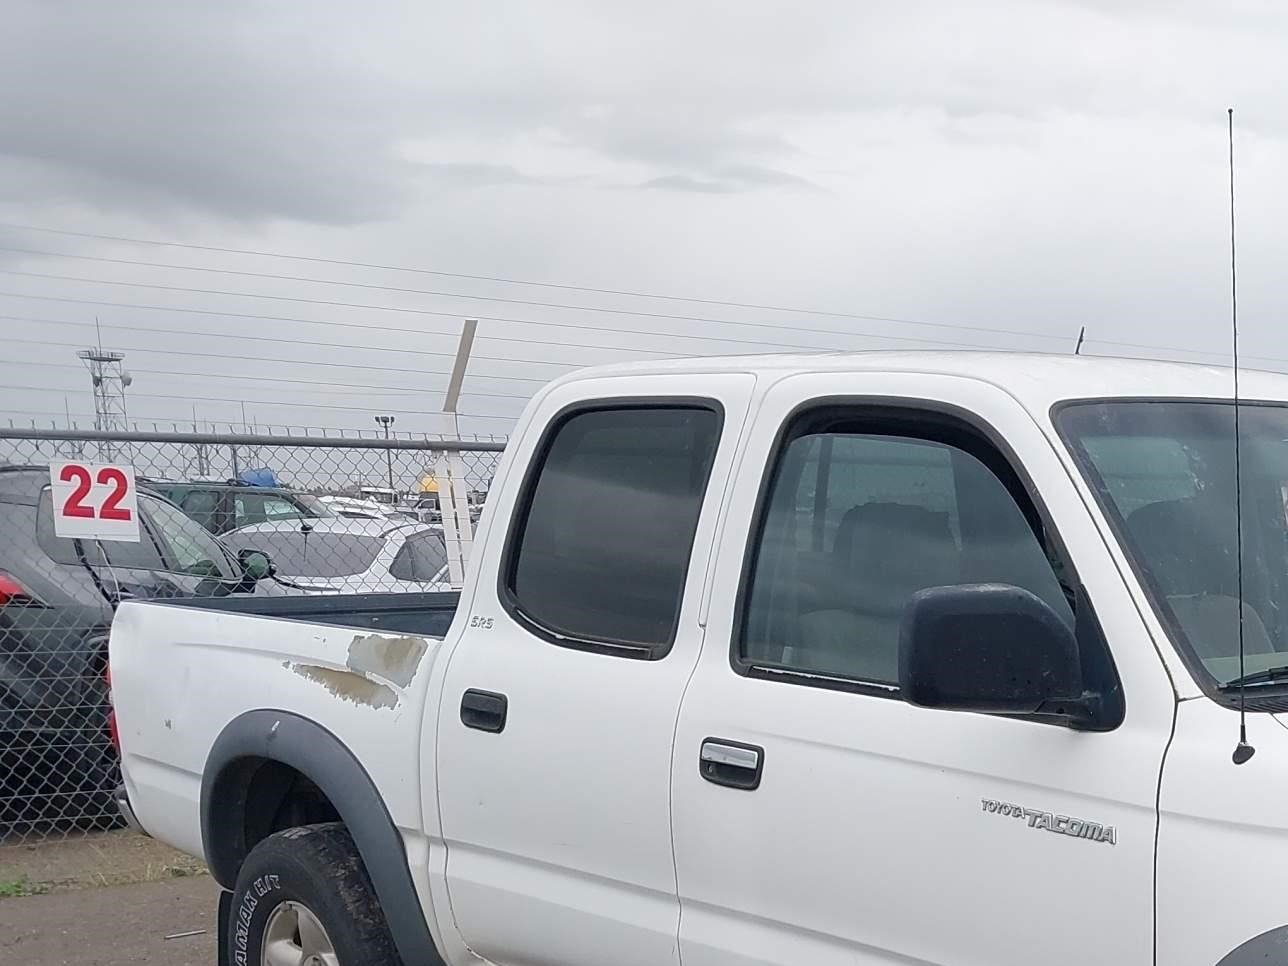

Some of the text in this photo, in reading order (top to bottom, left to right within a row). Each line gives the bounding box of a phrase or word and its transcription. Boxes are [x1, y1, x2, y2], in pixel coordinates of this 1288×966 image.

[60, 465, 132, 521] 22
[981, 799, 1117, 845] TOYOTA TACOMA
